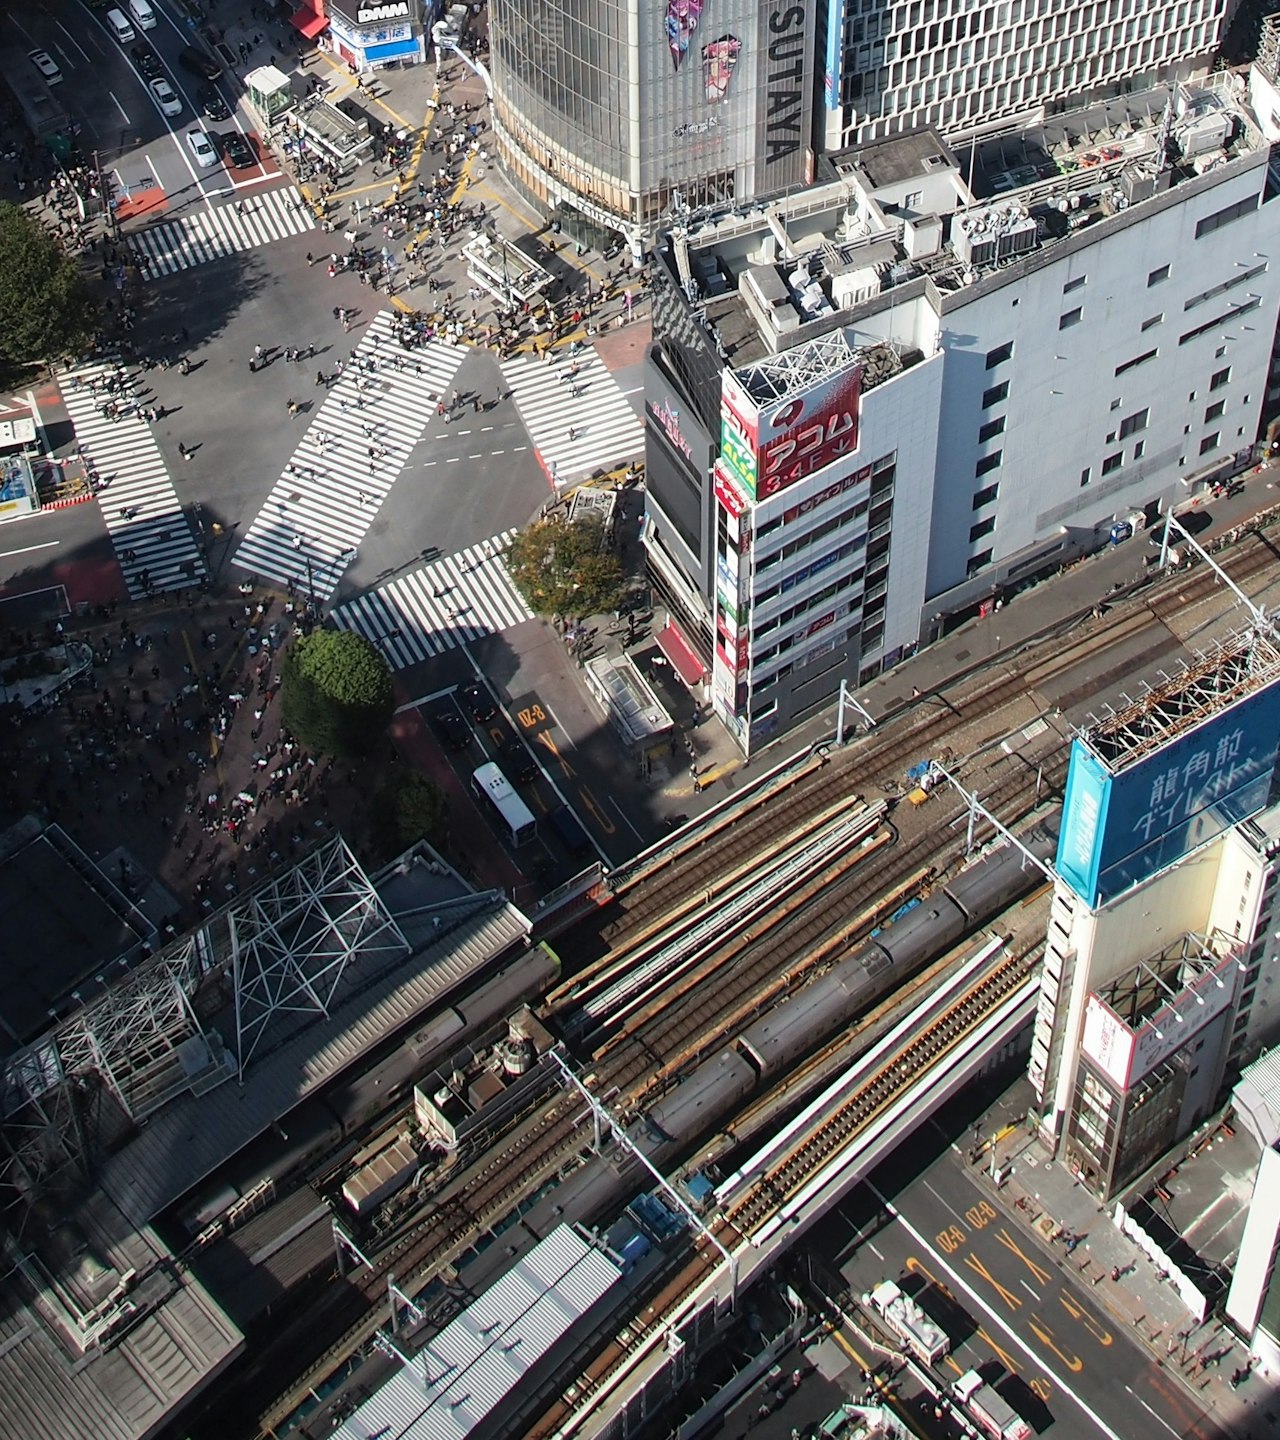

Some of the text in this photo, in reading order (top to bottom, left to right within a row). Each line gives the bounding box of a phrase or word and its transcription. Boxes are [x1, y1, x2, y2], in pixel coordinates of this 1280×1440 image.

[358, 2, 409, 24] DMM
[577, 199, 629, 235] TSUTAYA
[766, 412, 853, 474] アコム
[723, 443, 755, 487] ALSA
[814, 476, 854, 507] アイフル
[517, 703, 546, 728] 8-20
[1150, 728, 1244, 808] 龍角散
[964, 1199, 998, 1230] 8-20
[935, 1223, 967, 1254] 8-20
